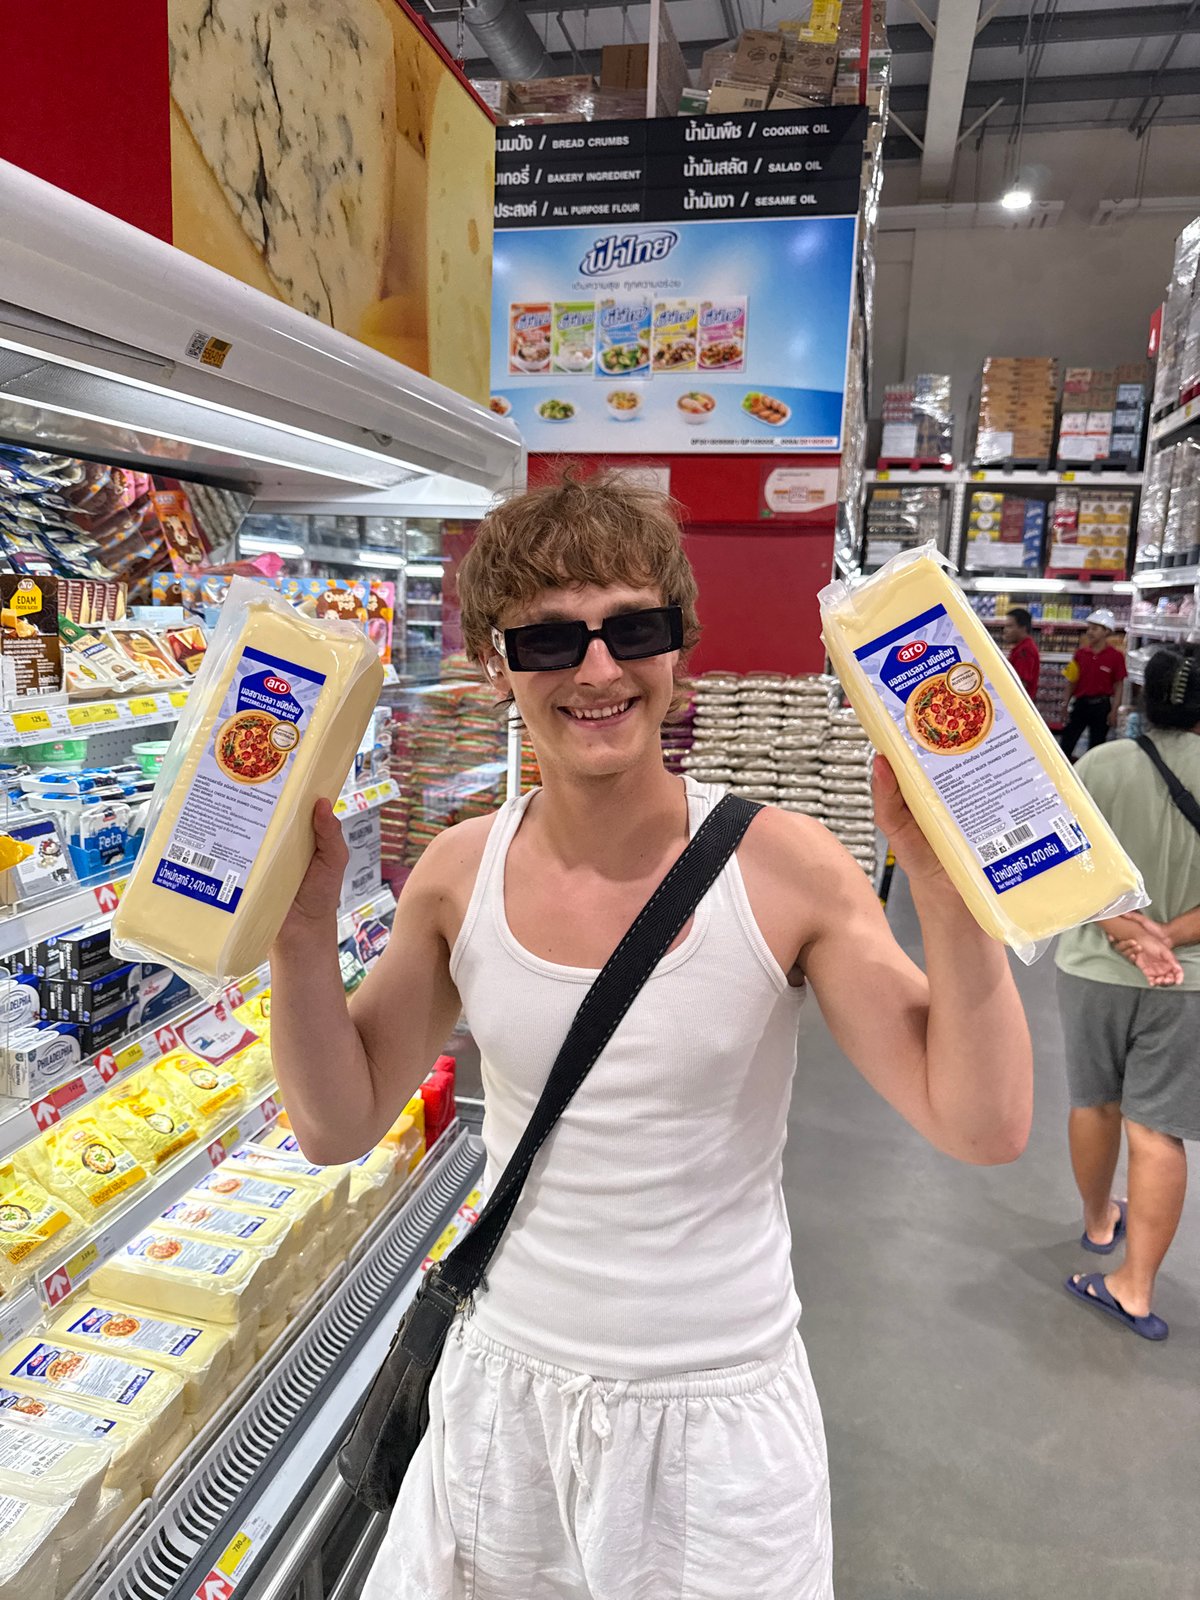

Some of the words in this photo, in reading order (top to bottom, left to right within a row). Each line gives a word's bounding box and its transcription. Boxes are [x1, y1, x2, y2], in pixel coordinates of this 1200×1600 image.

[686, 120, 742, 142] น้ำมันพืช
[748, 122, 756, 138] /
[762, 125, 810, 137] COOKINK
[812, 124, 830, 134] OIL
[539, 135, 546, 150] /
[552, 138, 585, 150] BREAD
[588, 136, 630, 148] CRUMBS
[535, 169, 542, 184] /
[548, 172, 582, 183] BAKERY
[586, 170, 642, 182] INGREDIENT
[684, 156, 748, 177] น้ำมันสลัด
[754, 158, 762, 174] /
[768, 162, 802, 173] SALAD
[805, 160, 822, 171] OIL
[542, 202, 548, 217] /
[552, 206, 568, 216] ALL
[570, 204, 610, 216] PURPOSE
[612, 202, 640, 214] FLOUR
[684, 190, 735, 210] น้ำมันงา
[740, 192, 749, 208] /
[755, 195, 796, 206] SESAME
[800, 194, 818, 204] OIL
[586, 235, 673, 274] ฟ้าไทย
[17, 596, 36, 605] EDAM
[901, 643, 923, 660] aro
[888, 662, 928, 687] มอสซาเรลลา
[927, 647, 954, 666] ชนิดก้อน
[894, 674, 924, 692] MOZZARELLA
[924, 664, 941, 678] CHEESE
[941, 657, 957, 669] BLOCK
[267, 678, 287, 692] aro
[952, 672, 976, 686] AUSTRALIA
[240, 687, 276, 705] มอสซาเรลลา
[276, 700, 301, 714] ชนิดก้อน
[240, 696, 266, 709] MOZZARELLA
[266, 705, 281, 715] CHEESE
[282, 710, 296, 720] BLOCK
[98, 833, 122, 850] Feta
[989, 857, 1028, 883] น้ำหนักสุทธิ
[1024, 849, 1046, 868] 2,470
[1044, 842, 1059, 857] กรัม
[159, 862, 190, 886] น้ำหนักสุทธิ
[188, 878, 206, 892] 2,470
[204, 883, 218, 896] กรัม
[37, 1046, 73, 1071] PHILADELPHIA
